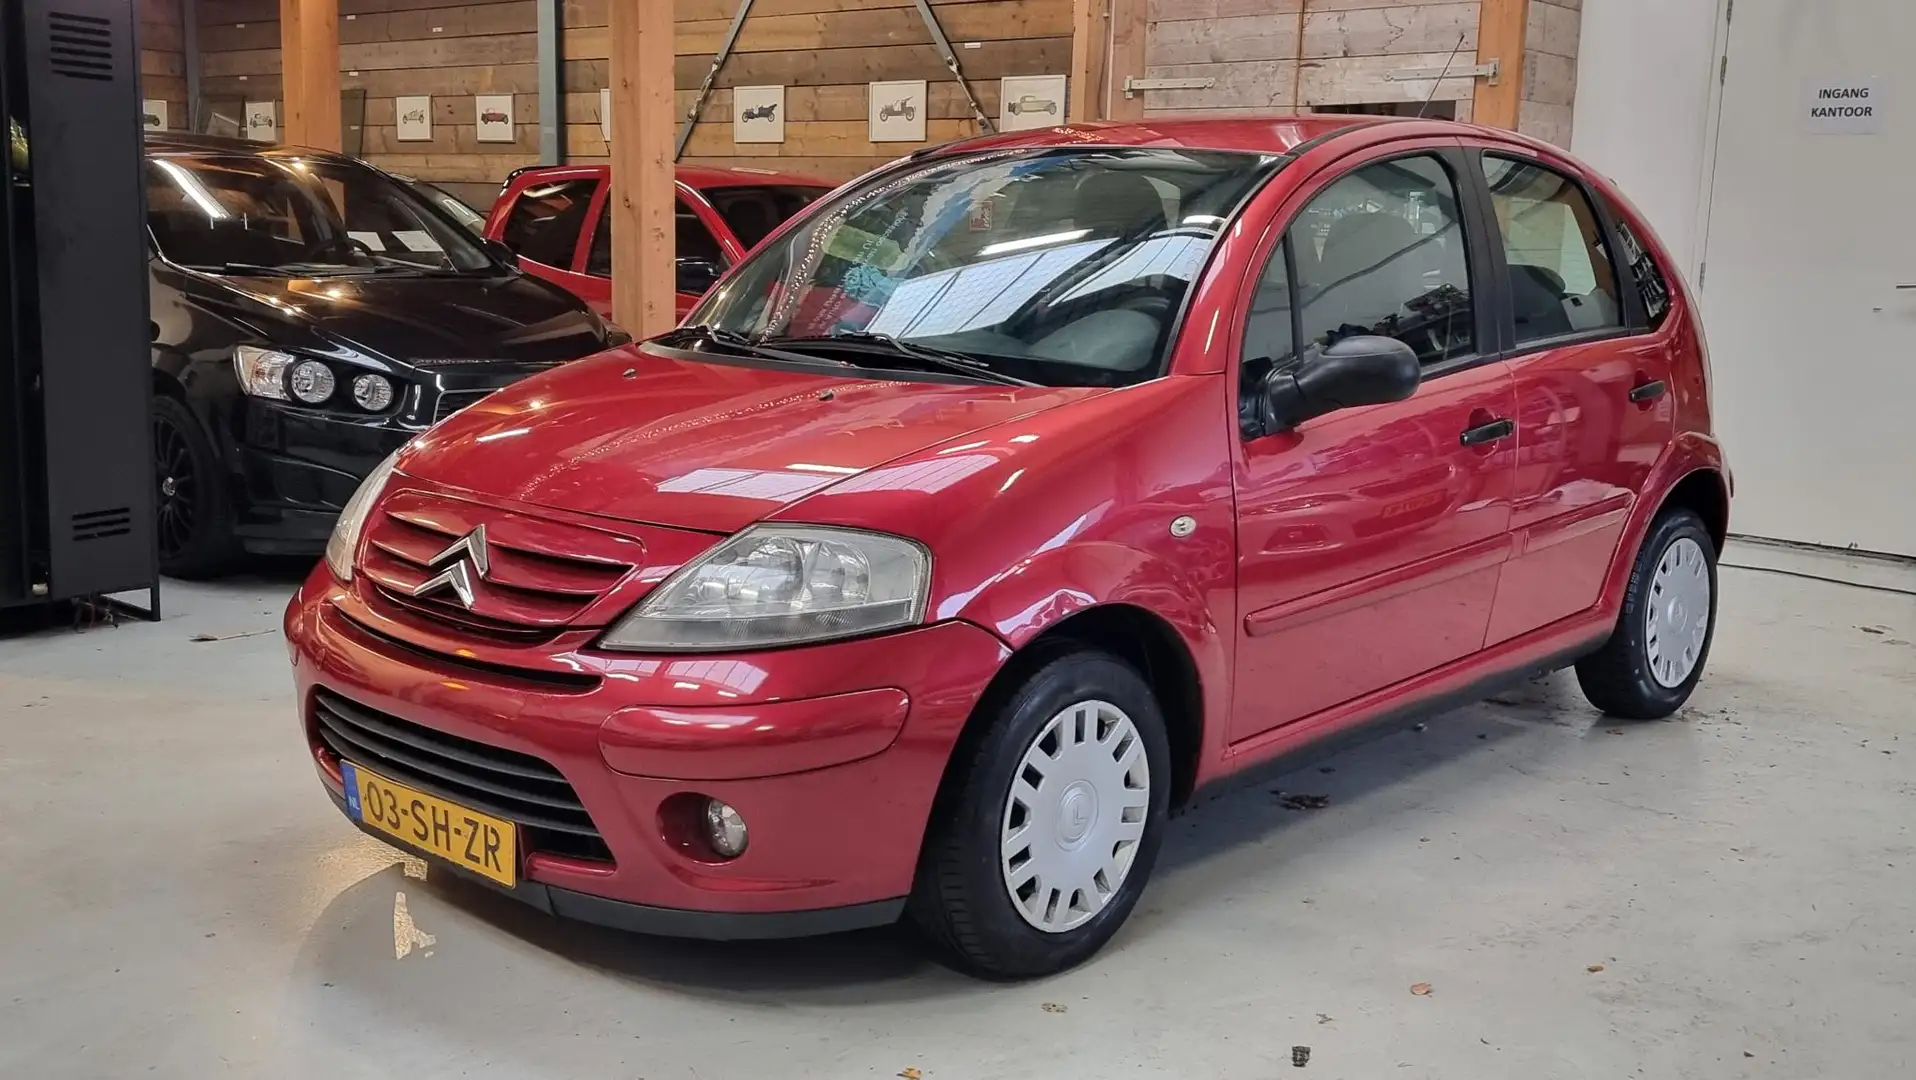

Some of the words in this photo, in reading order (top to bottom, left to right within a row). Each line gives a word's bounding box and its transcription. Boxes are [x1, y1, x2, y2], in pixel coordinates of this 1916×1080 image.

[1819, 88, 1869, 99] INGANG
[1811, 106, 1872, 117] KANTOOR
[366, 780, 502, 873] 03-SH-ZR
